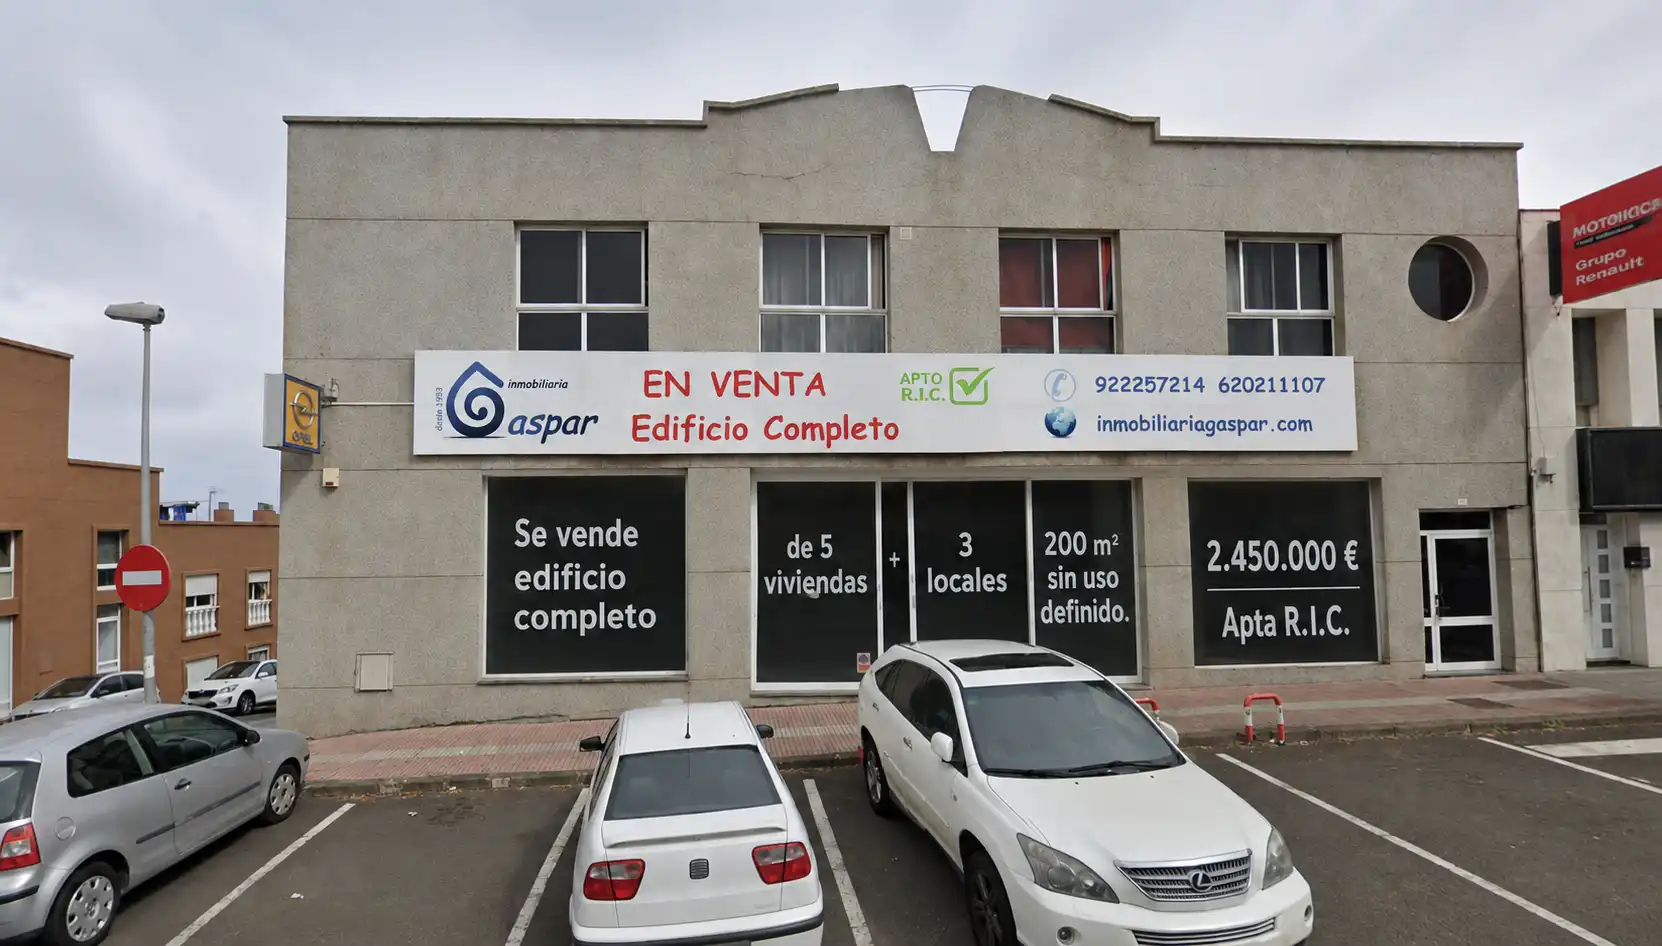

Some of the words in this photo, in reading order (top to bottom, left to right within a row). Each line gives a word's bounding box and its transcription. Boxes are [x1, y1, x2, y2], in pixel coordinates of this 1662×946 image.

[1576, 249, 1627, 271] Grupo
[1576, 256, 1645, 285] Renault
[508, 379, 568, 388] inmobiliaria
[644, 370, 690, 398] EN
[712, 370, 826, 398] VENTA
[900, 372, 943, 385] APTO
[1096, 376, 1205, 393] 922257214
[1219, 377, 1325, 393] 620211107
[901, 387, 946, 402] R.I.C.
[632, 414, 748, 443] Edificio
[764, 414, 899, 448] Completo
[1098, 414, 1312, 437] inmobiliariagaspar.com
[515, 518, 547, 547] Se
[556, 519, 638, 547] vende
[959, 532, 972, 557] 3
[1045, 531, 1086, 555] 200
[787, 534, 813, 558] de
[821, 534, 832, 558] 5
[1207, 540, 1336, 571] 2.450.000
[1344, 540, 1358, 570] €
[515, 563, 625, 590] edificio
[764, 569, 868, 594] viviendas
[928, 567, 1007, 592] locales
[1048, 565, 1076, 589] sin
[1084, 571, 1119, 589] uso
[514, 602, 656, 636] completo
[1041, 598, 1129, 623] definido.
[1222, 607, 1276, 644] Apta
[1285, 605, 1349, 636] R.I.C.
